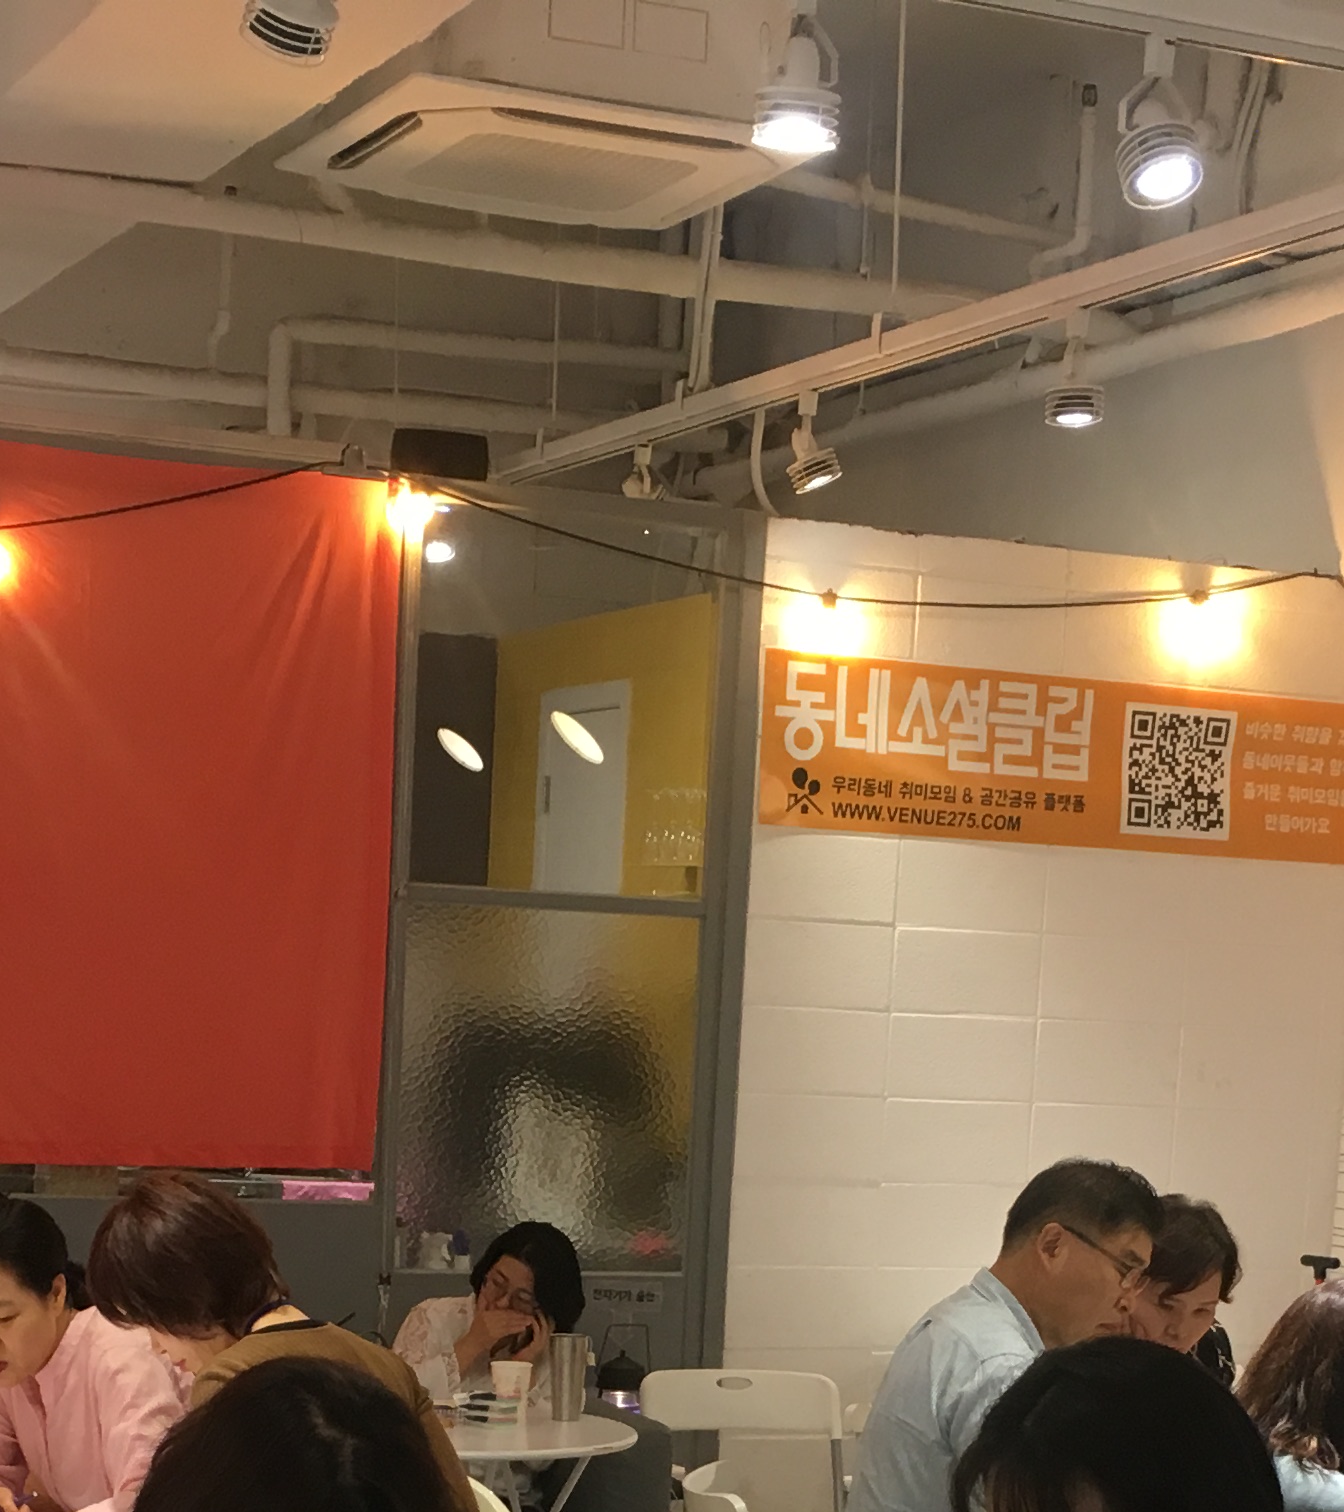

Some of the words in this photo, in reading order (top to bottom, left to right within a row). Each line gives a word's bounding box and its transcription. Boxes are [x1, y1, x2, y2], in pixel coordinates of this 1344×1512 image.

[775, 661, 1094, 782] 동네소셜클럽
[1245, 721, 1287, 741] 비슷한
[831, 776, 892, 797] 우리동네
[899, 781, 957, 803] 취미모임
[963, 787, 973, 804] &
[980, 787, 1036, 810] 공간공유
[1044, 792, 1086, 813] 플랫폼
[832, 802, 1021, 831] WWW.VENUE275.COM
